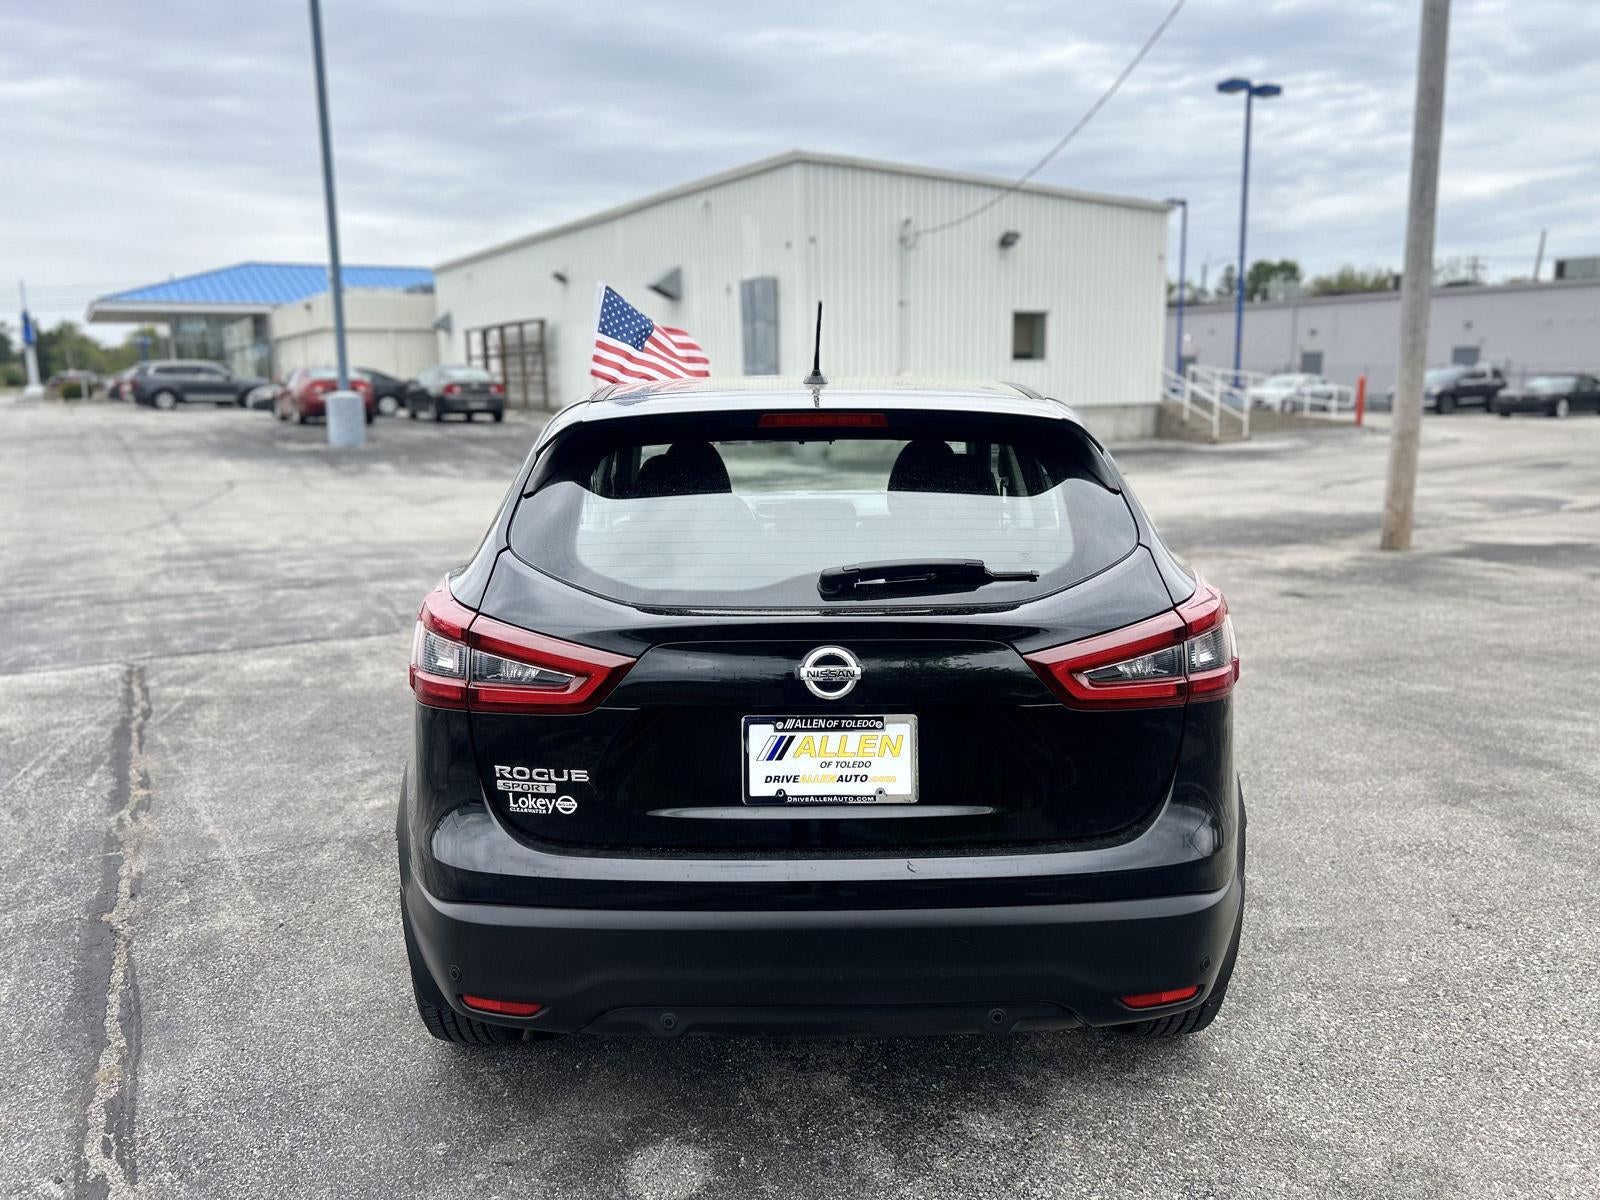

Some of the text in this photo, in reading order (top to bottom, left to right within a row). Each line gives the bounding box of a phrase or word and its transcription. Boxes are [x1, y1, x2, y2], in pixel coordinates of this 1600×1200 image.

[806, 670, 855, 679] NISSAN
[794, 719, 876, 729] ALLEN OF TOLEDO
[793, 735, 904, 758] ALLEN
[820, 760, 872, 769] OF TOLEDO
[494, 765, 590, 782] ROGUE
[502, 782, 551, 792] SPORT
[508, 793, 556, 814] Lokey
[510, 806, 547, 814] CLEARWATER
